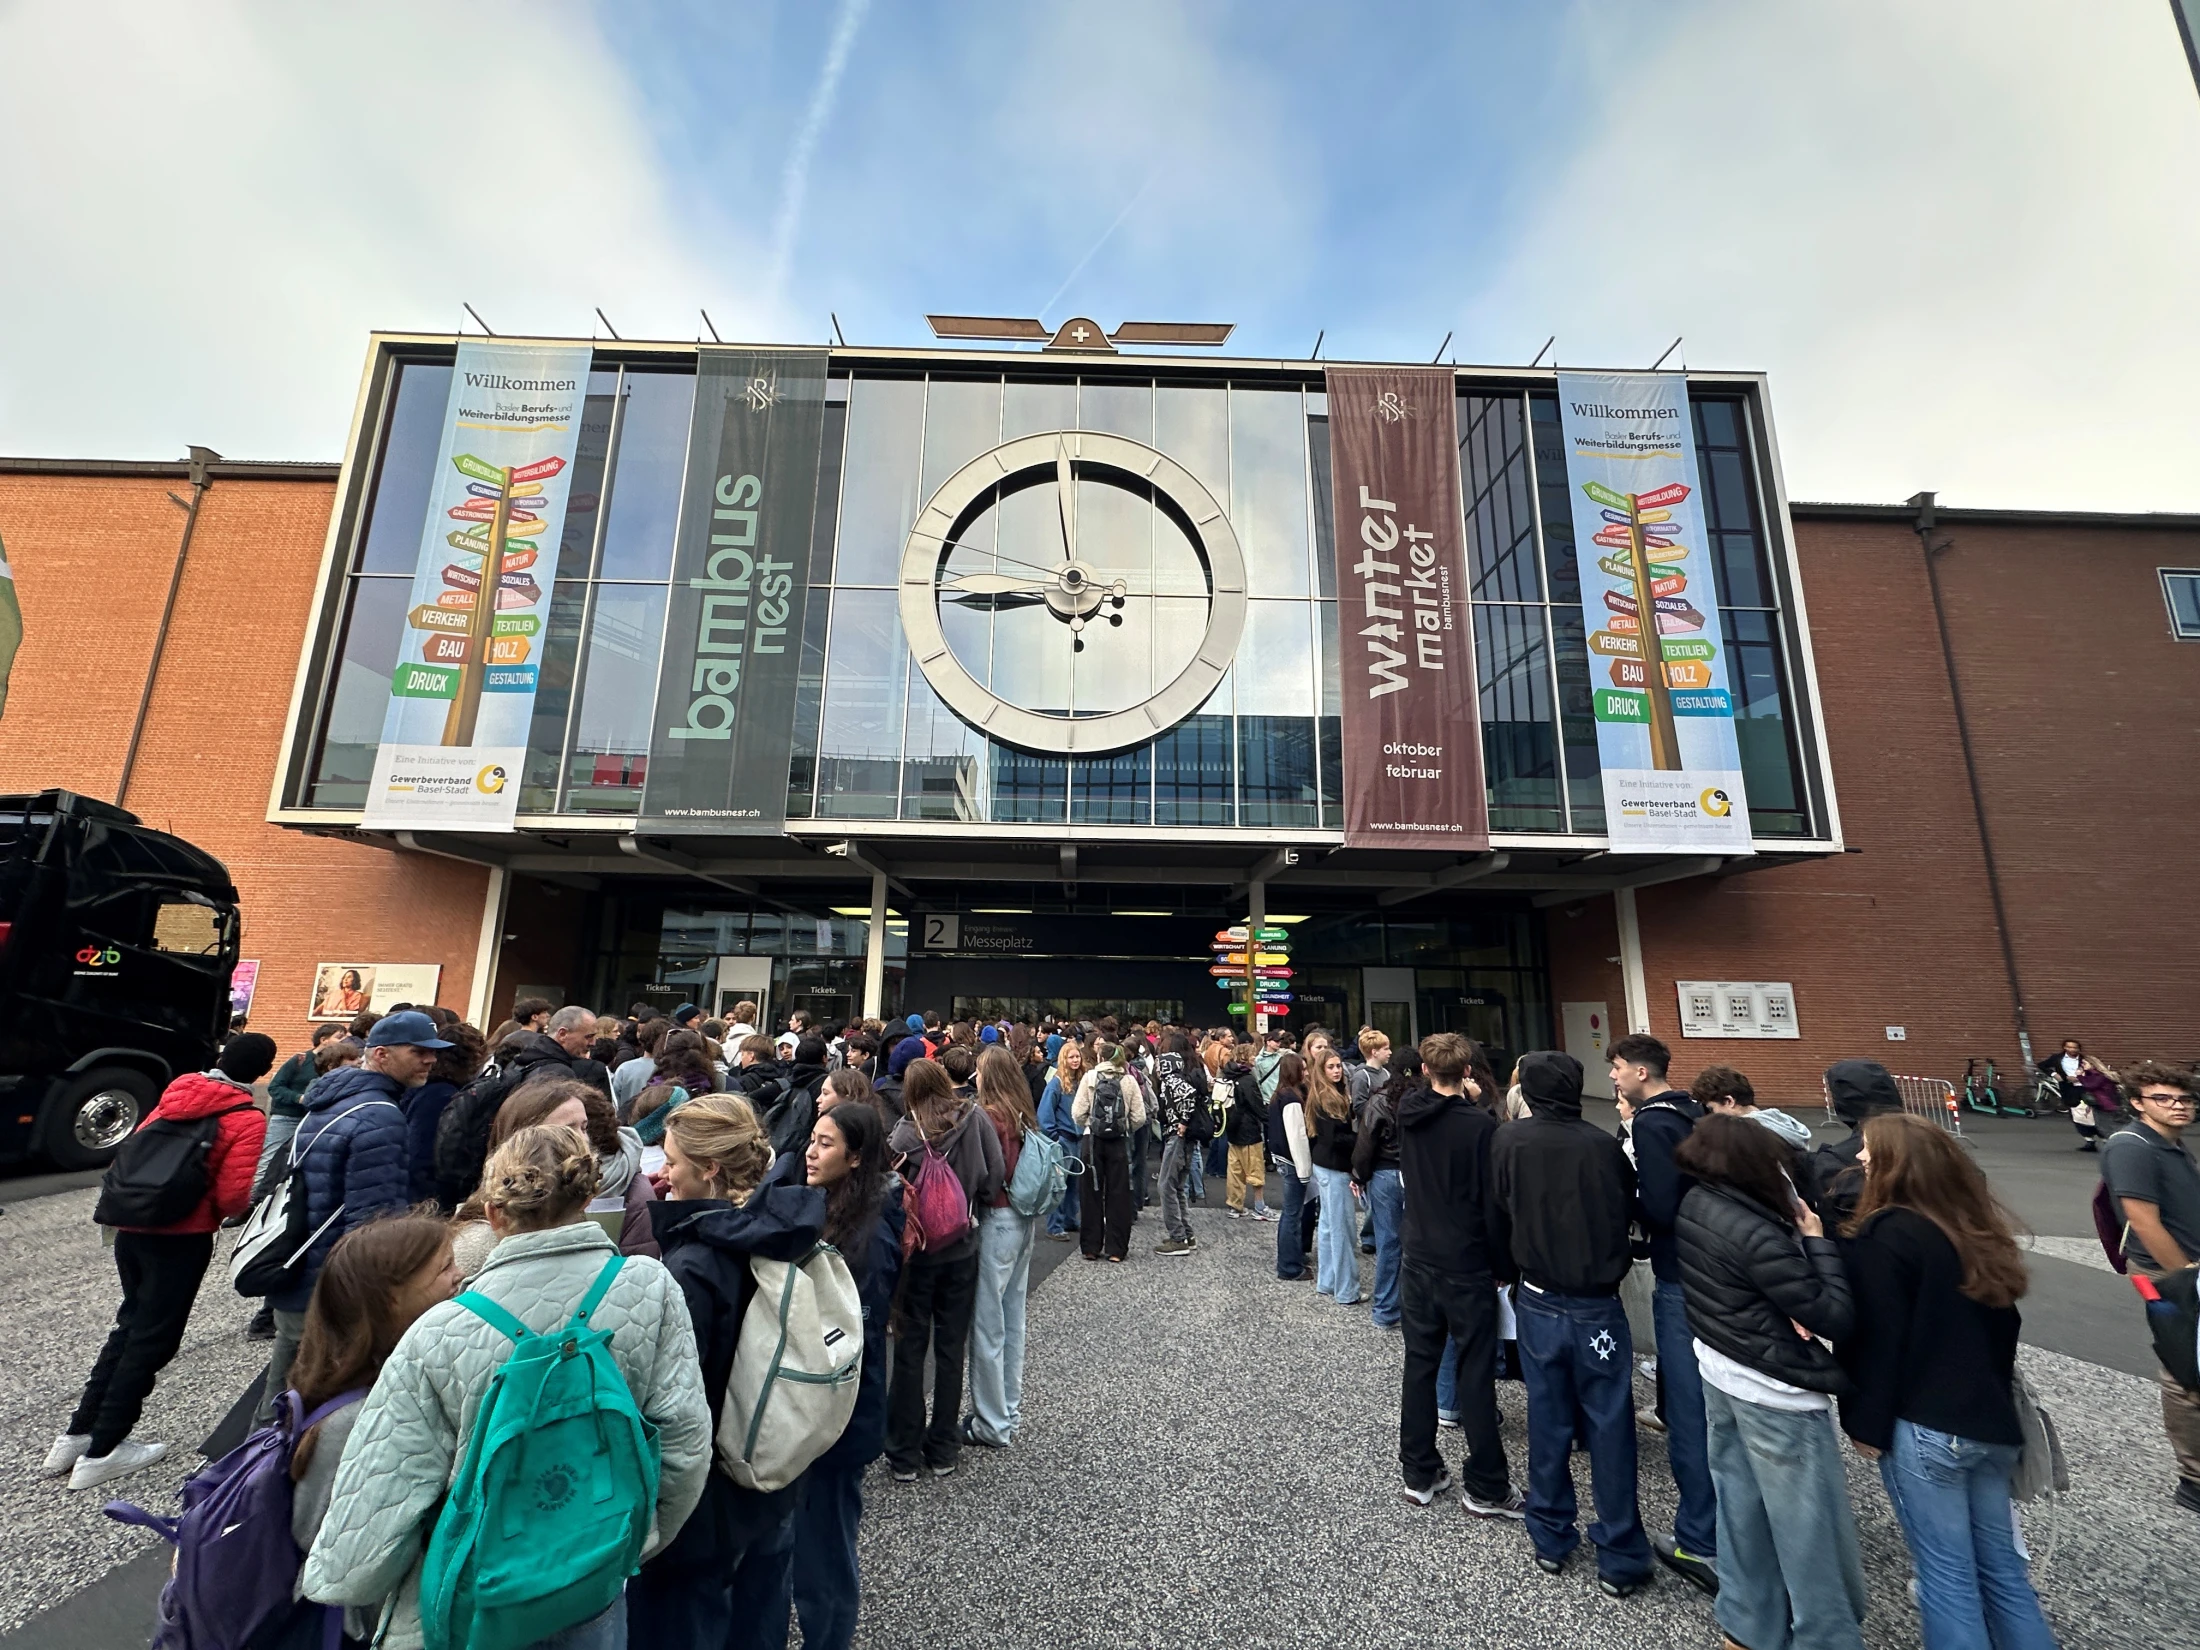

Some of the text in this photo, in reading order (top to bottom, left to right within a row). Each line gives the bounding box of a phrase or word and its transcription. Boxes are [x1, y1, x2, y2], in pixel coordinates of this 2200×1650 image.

[463, 372, 576, 391] Willkommen
[495, 402, 573, 413] Basler Berufs- und
[1570, 402, 1679, 419] Willkommen
[458, 408, 571, 424] Weiterbildungsmesse
[1605, 431, 1681, 441] Basler Berufs- und
[1574, 437, 1682, 451] Weiterbildungsmesse
[462, 458, 503, 482] GRUNDBILDUNG
[513, 460, 559, 480] WEITERBILDUNG
[471, 484, 502, 498] GESUNDHEIT
[1591, 485, 1629, 508] GRUNDBILDUNG
[1637, 486, 1683, 506] WEITERBILDUNG
[452, 509, 495, 520] GASTRONOMIE
[1604, 511, 1632, 524] GESUNDHEIT
[455, 534, 489, 552] PLANUNG
[1596, 535, 1631, 546] GASTRONOMIE
[505, 553, 529, 568] NATUR
[1605, 561, 1635, 577] PLANUNG
[447, 568, 481, 587] WIRTSCHAFT
[501, 574, 530, 586] SOZIALES
[1654, 579, 1678, 593] NATUR
[440, 593, 474, 604] METALL
[753, 553, 794, 654] nest
[1403, 523, 1444, 670] market
[1439, 565, 1453, 630] bambusnest
[1607, 595, 1638, 612] WIRTSCHAFT
[668, 473, 763, 741] bambus
[1655, 600, 1688, 611] SOZIALES
[421, 609, 468, 627] VERKEHR
[1610, 619, 1638, 630] METALL
[496, 620, 534, 632] TEXTILIEN
[436, 639, 465, 658] BAU
[1599, 635, 1638, 653] VERKEHR
[1664, 644, 1708, 657] TEXTILIEN
[489, 672, 534, 685] GESTALTUNG
[1621, 664, 1644, 682] BAU
[406, 671, 449, 692] DRUCK
[1607, 695, 1641, 716] DRUCK
[1675, 696, 1728, 709] GESTALTUNG
[1383, 742, 1443, 757] oktober
[395, 755, 415, 764] Eine
[417, 756, 456, 765] Initiative
[1386, 764, 1442, 779] februar
[390, 774, 472, 785] Gewerbeverband
[1620, 780, 1637, 788] Eine
[1639, 780, 1674, 789] Initiative
[417, 785, 470, 794] Basel-Stadt
[1621, 799, 1696, 808] Gewerbeverband
[664, 807, 761, 817] www.bambusnest.ch
[1649, 809, 1698, 818] Basel-Stadt
[1370, 821, 1463, 832] www.bambusnest.ch
[927, 919, 945, 944] 2
[964, 924, 991, 934] Eingang
[963, 935, 1034, 951] Messeplatz
[645, 984, 671, 992] Tickets
[811, 986, 837, 994] Tickets
[1260, 980, 1281, 988] DRUCK
[1299, 994, 1325, 1003] Tickets
[1459, 997, 1485, 1005] Tickets
[1263, 1005, 1278, 1013] BAU
